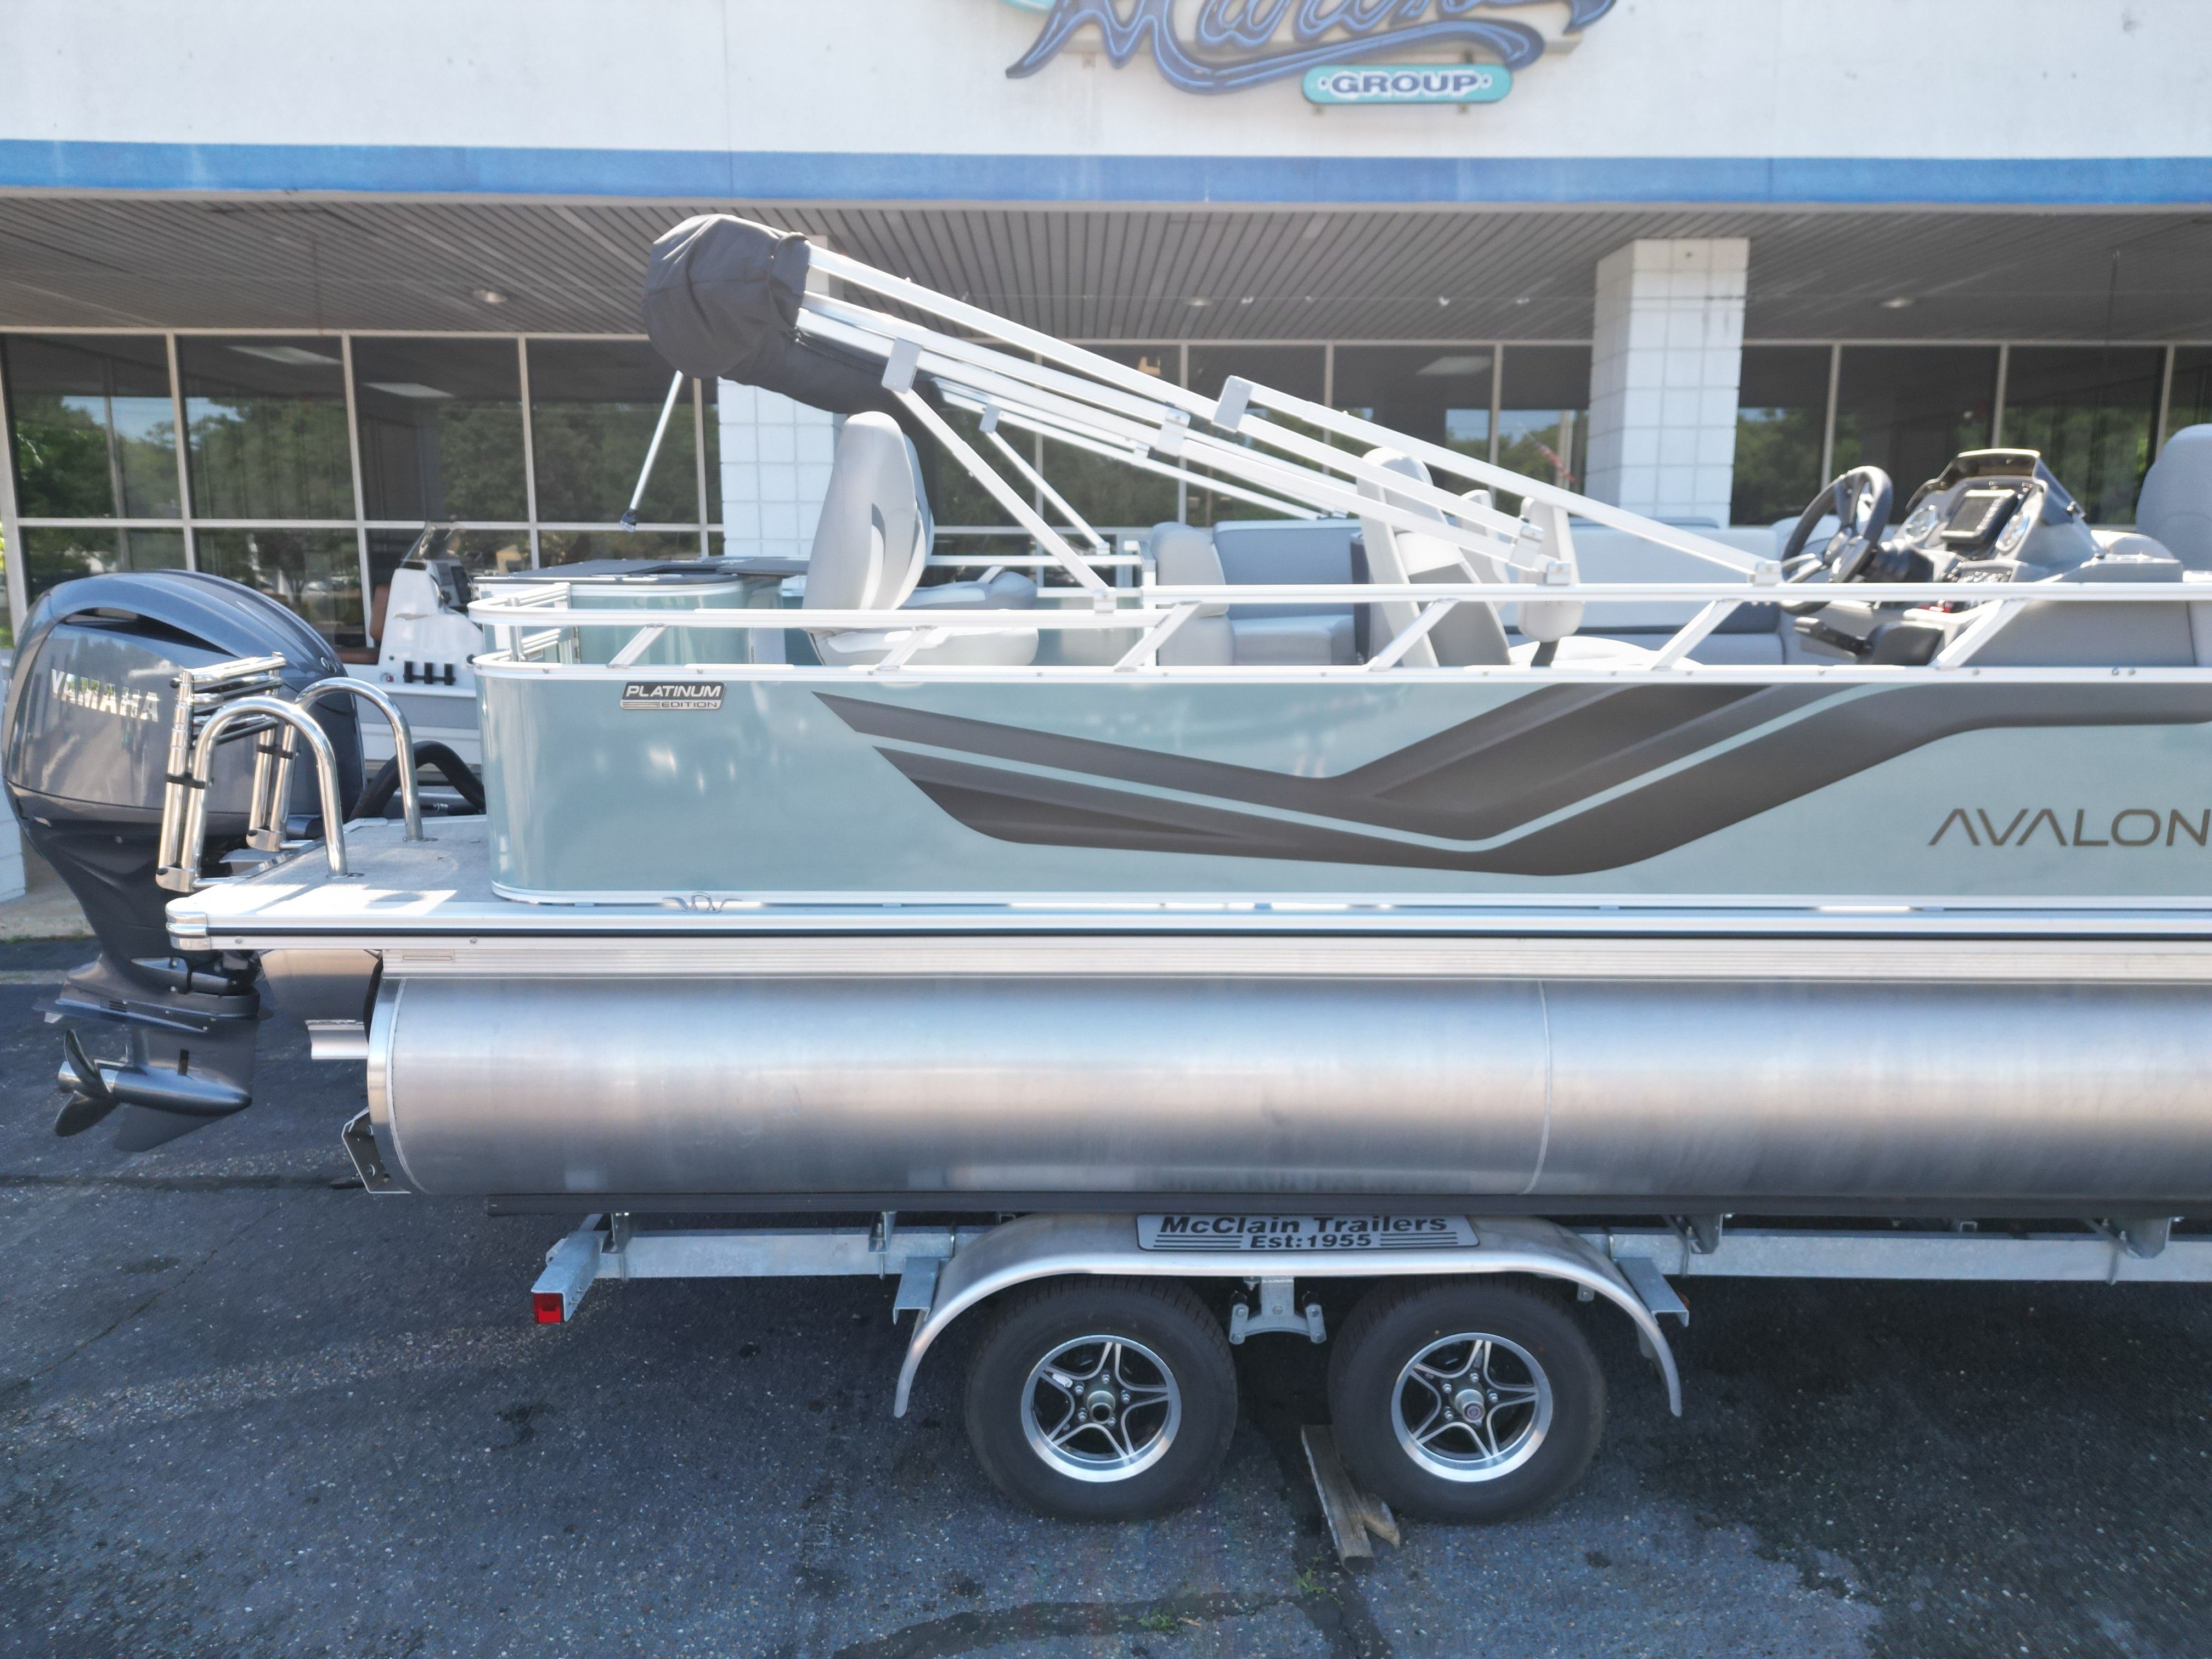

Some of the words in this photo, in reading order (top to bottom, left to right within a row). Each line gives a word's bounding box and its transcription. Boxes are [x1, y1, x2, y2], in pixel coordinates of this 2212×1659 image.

[1331, 74, 1479, 93] GROUP
[625, 685, 722, 697] PLATINUM
[1927, 808, 2211, 847] AVALON
[1160, 1216, 1301, 1234] McClain
[1313, 1215, 1447, 1233] Trailers
